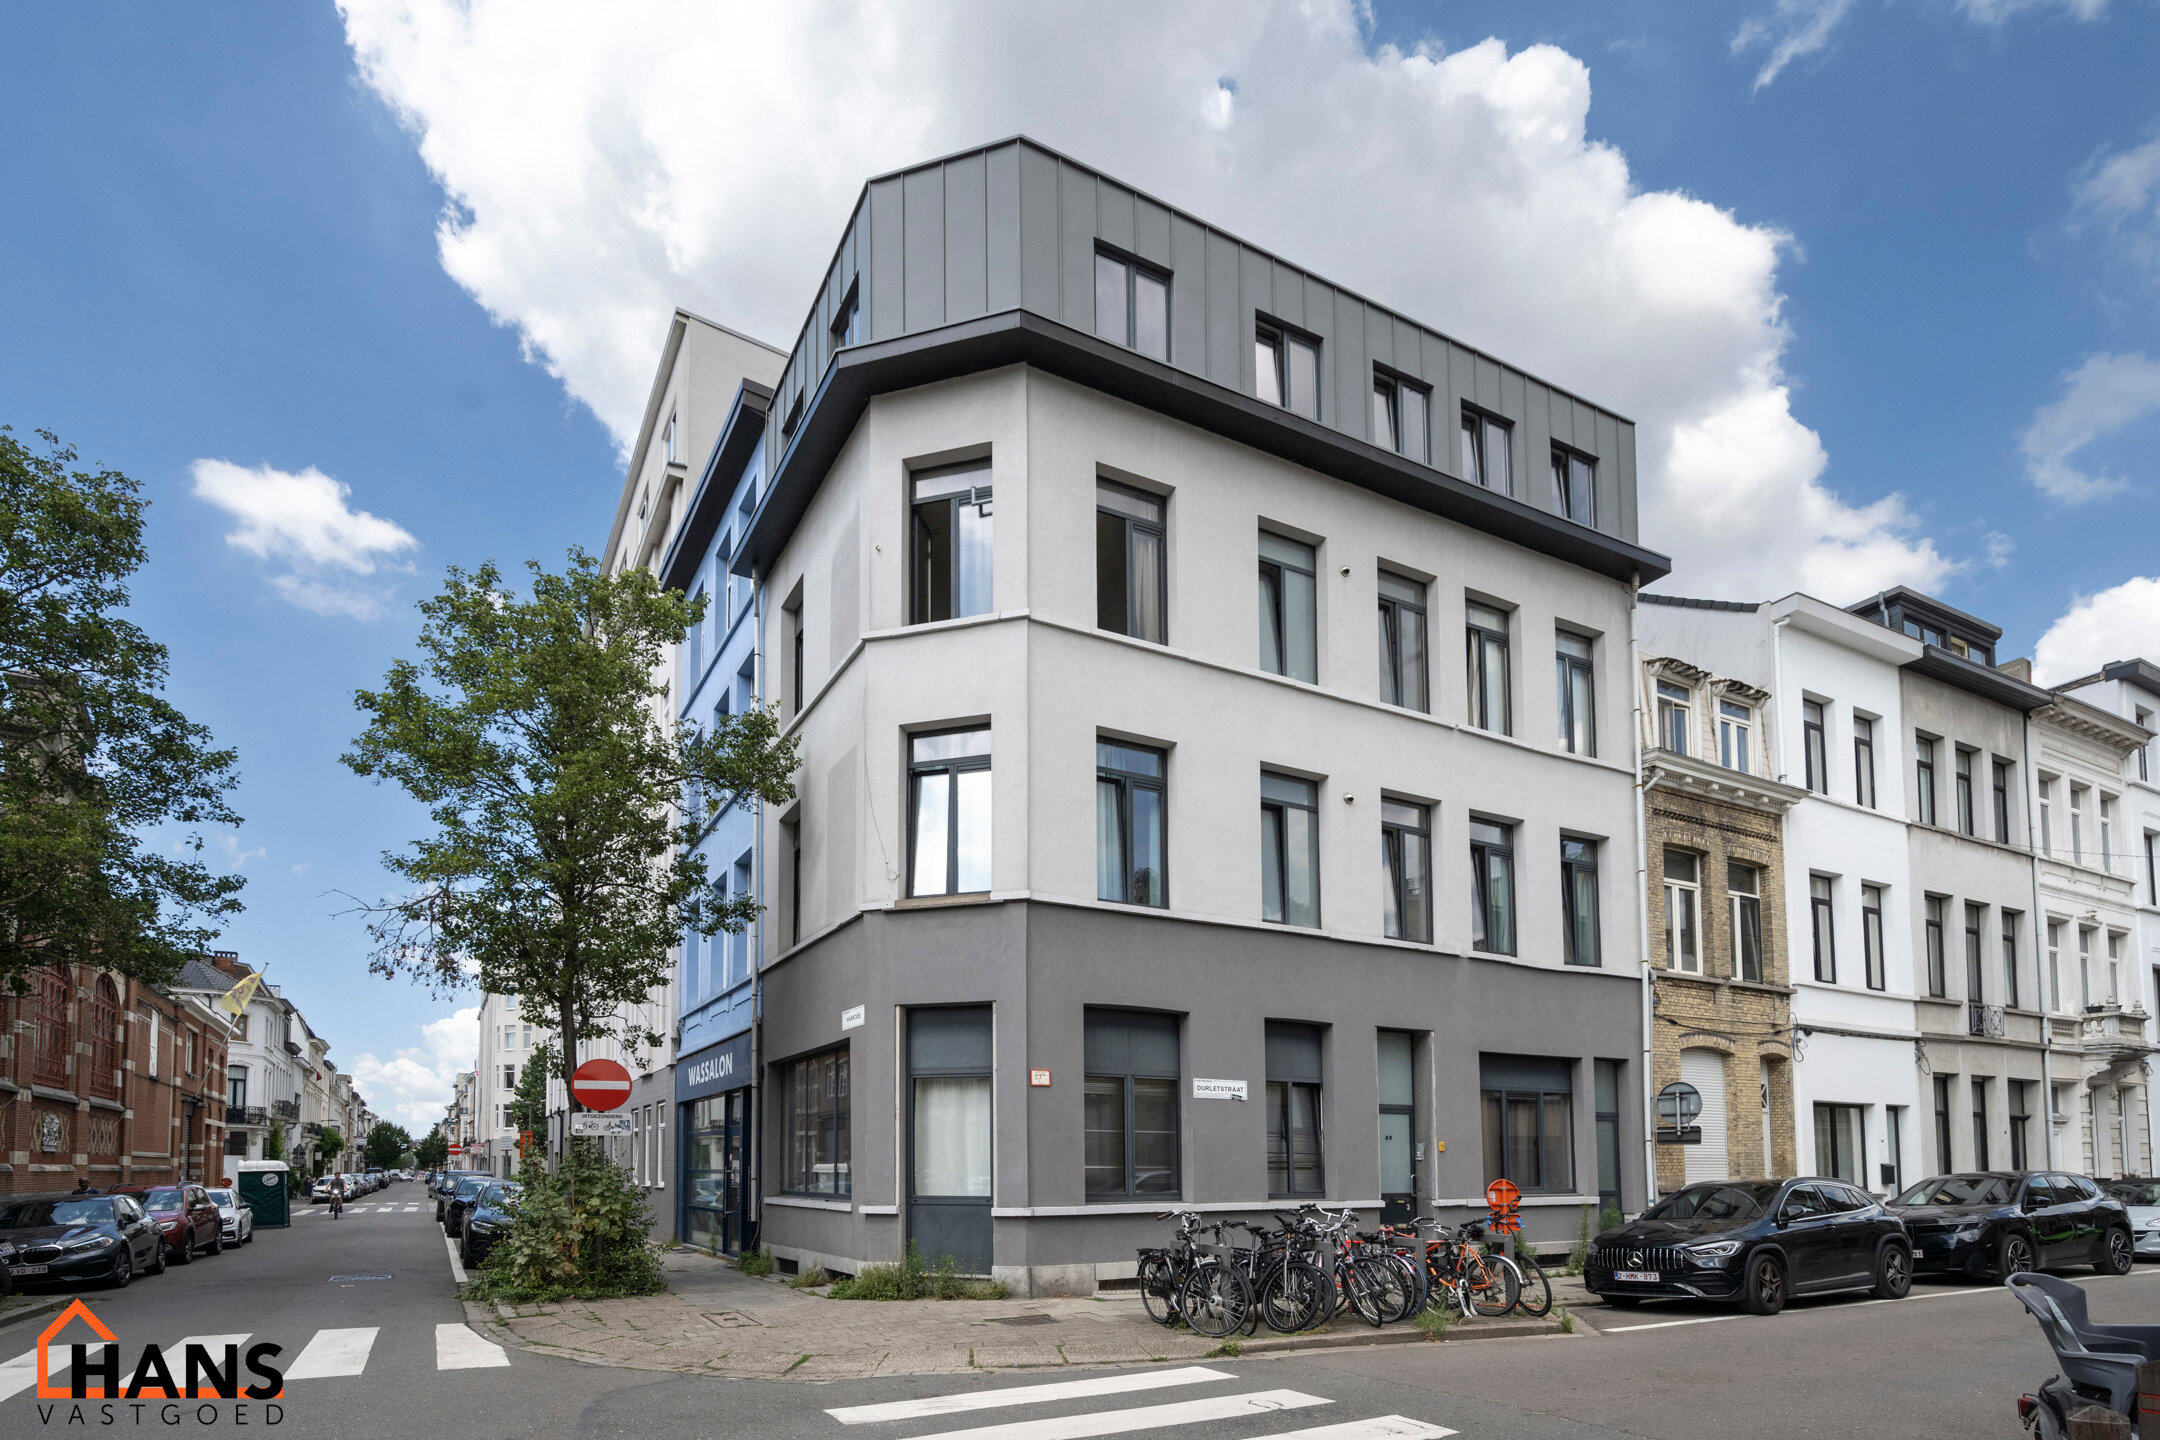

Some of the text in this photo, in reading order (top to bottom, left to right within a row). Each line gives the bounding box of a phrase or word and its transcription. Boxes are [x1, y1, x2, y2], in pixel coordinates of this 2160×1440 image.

[688, 1053, 733, 1086] WASSALON
[1196, 1084, 1244, 1093] DURLETSTRAAT
[1406, 1203, 1411, 1211] 3
